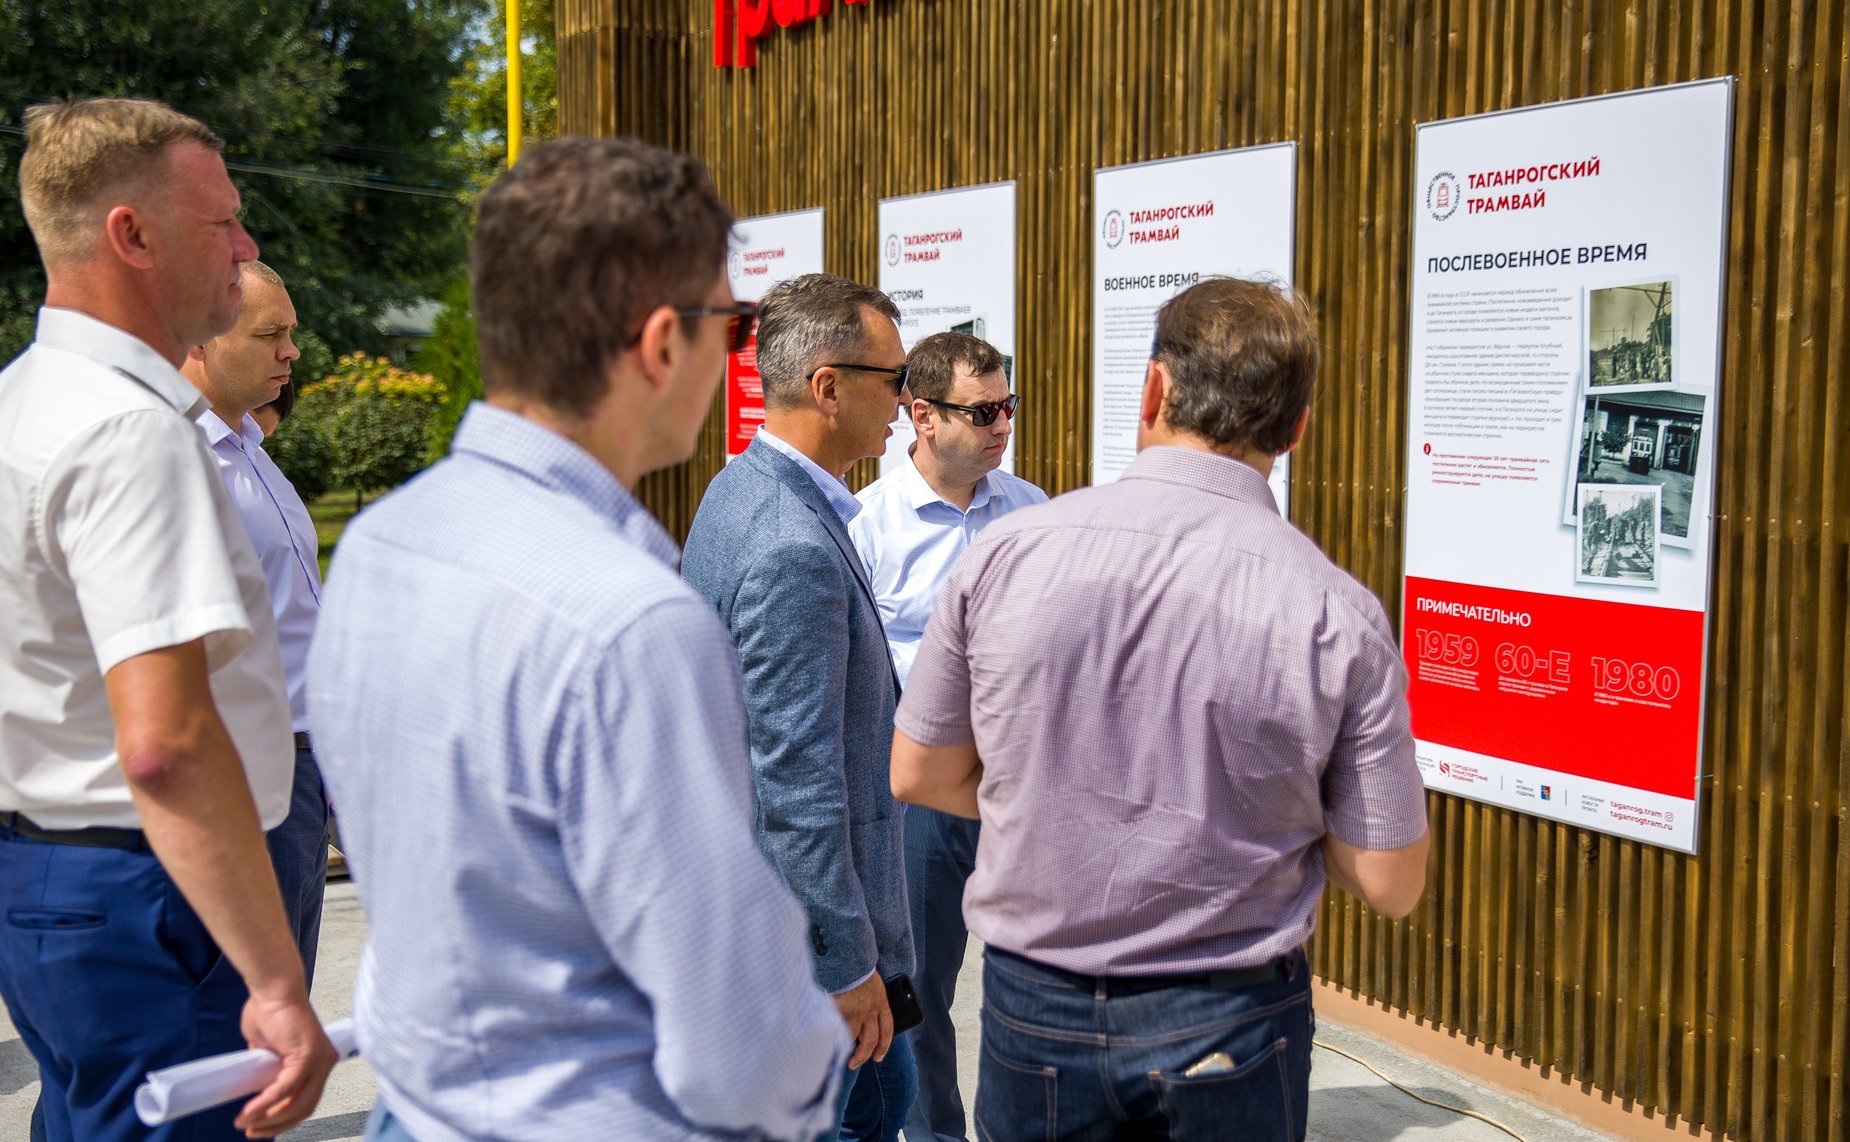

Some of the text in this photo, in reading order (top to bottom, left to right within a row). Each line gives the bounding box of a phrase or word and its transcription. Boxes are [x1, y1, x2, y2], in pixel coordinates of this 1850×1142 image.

[1468, 156, 1600, 189] ТАГАНРОГСКИЙ
[1467, 188, 1546, 214] ТРАМВАЙ
[1130, 200, 1214, 224] ТАГАНРОГСКИЙ
[904, 228, 962, 247] ТАГАНРОГСКИЙ
[1129, 225, 1180, 244] ТРАМВАЙ
[904, 248, 940, 264] ТРАМВАЙ
[1428, 243, 1648, 274] ПОСЛЕВОЕННОЕ ВРЕМЯ
[1104, 272, 1199, 291] ВОЕННОЕ ВРЕМЯ
[1416, 597, 1532, 627] ПРИМЕЧАТЕЛЬНО
[1416, 628, 1480, 667] 1959
[1591, 656, 1680, 700] 1980
[1610, 801, 1662, 818] taganrog.tram
[1610, 811, 1673, 830] taganrogtram.ru
